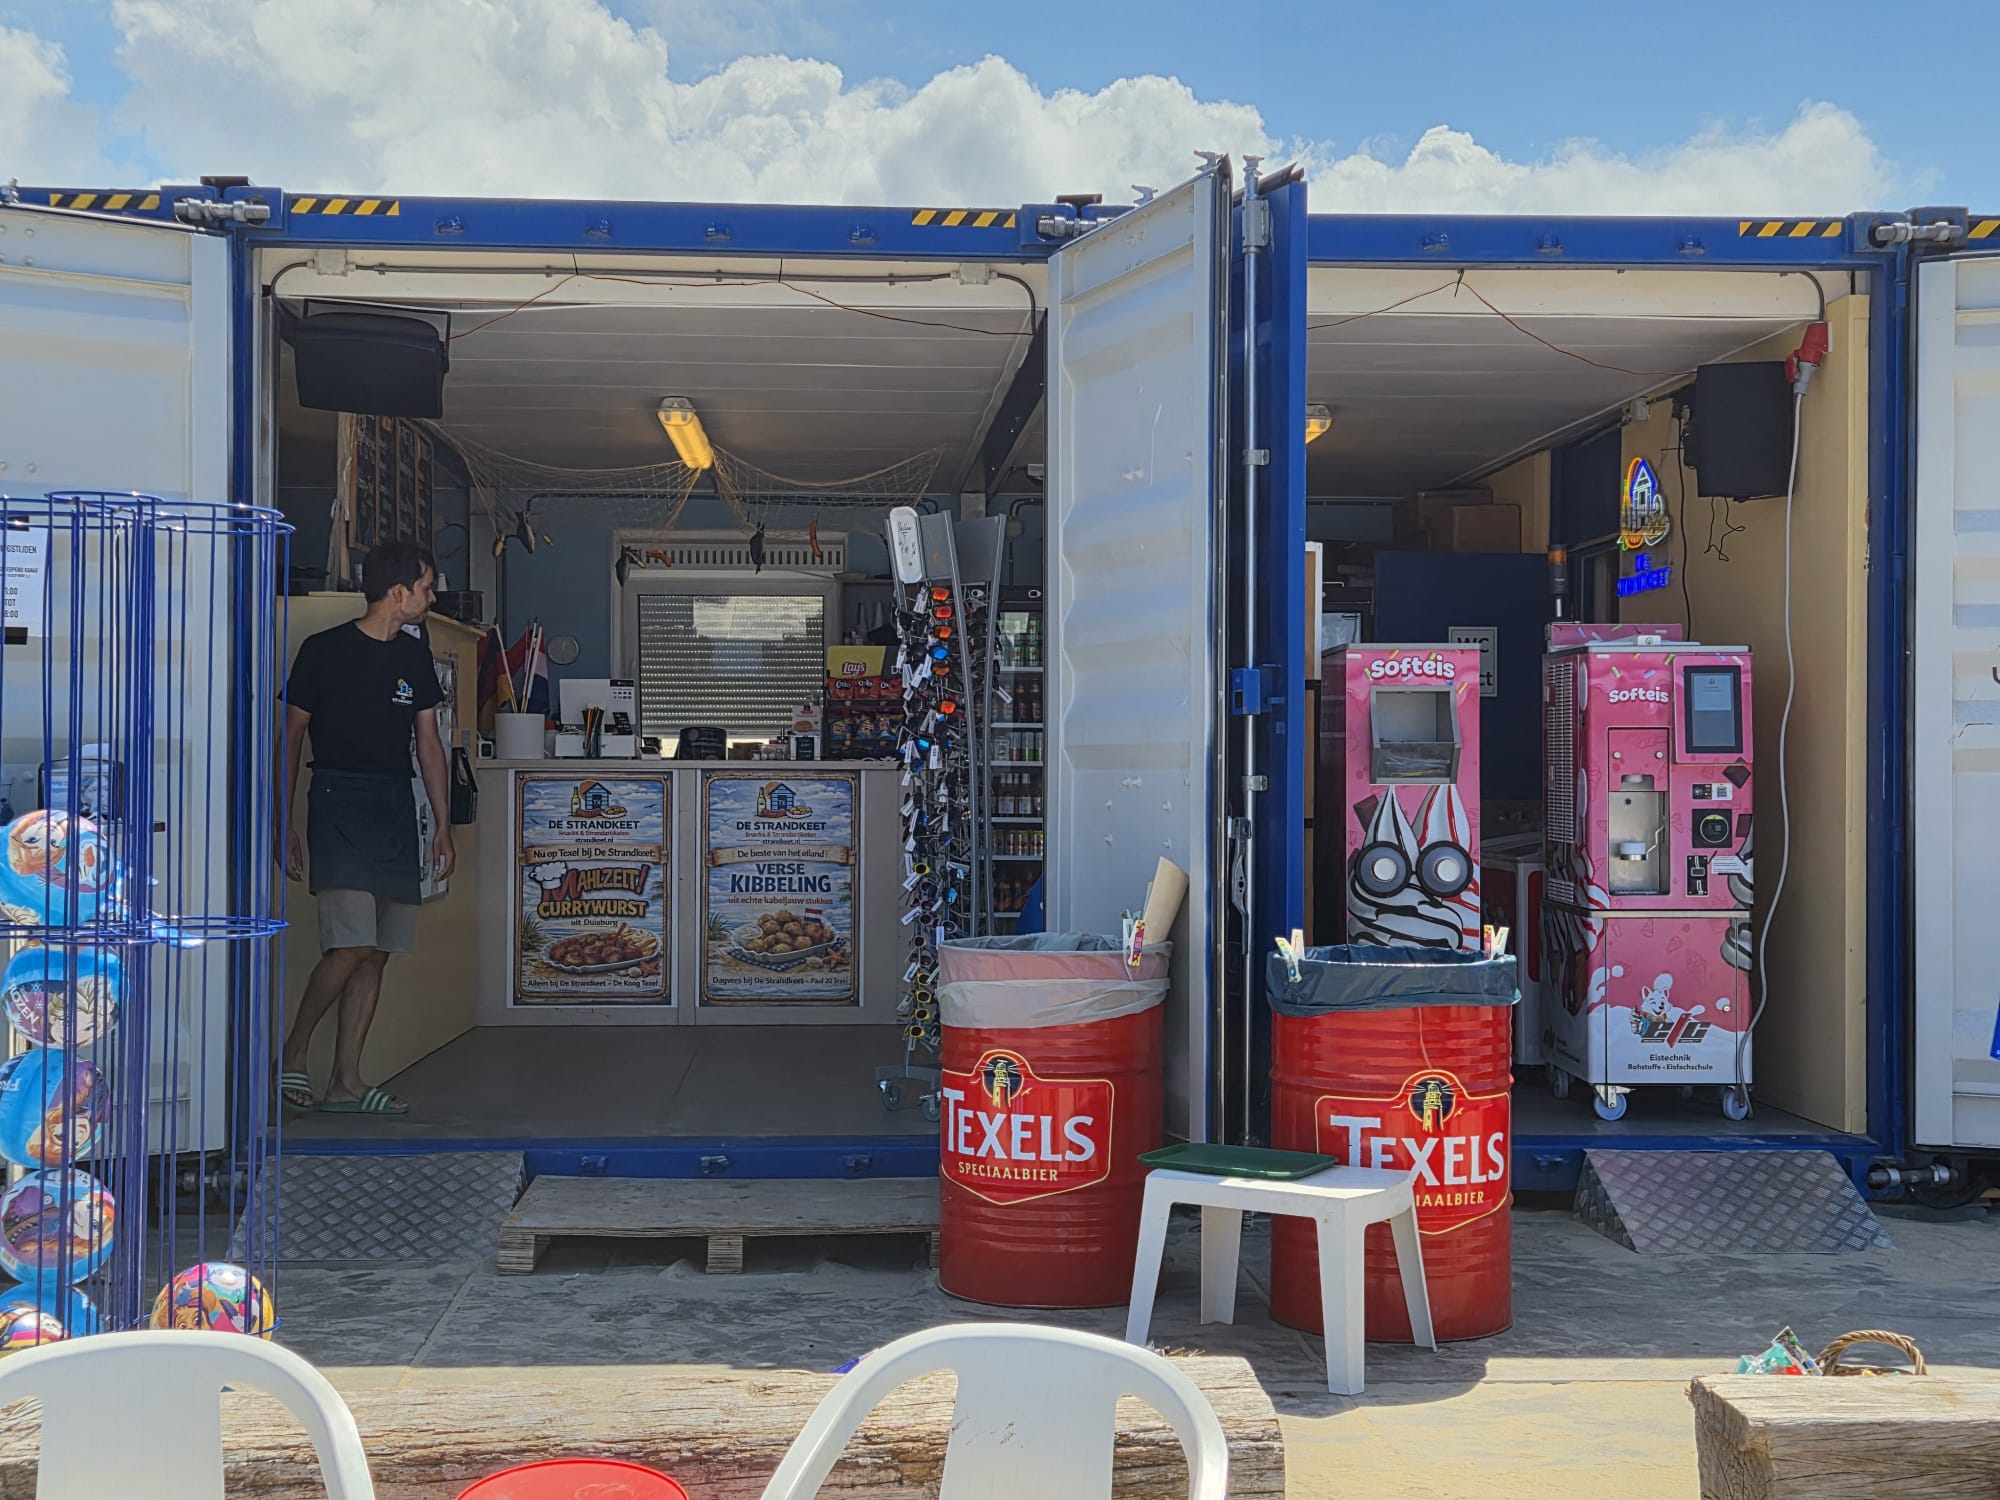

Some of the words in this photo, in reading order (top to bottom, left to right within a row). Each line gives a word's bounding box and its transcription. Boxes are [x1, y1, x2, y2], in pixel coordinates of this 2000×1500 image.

[1, 544, 37, 554] GSTIJDEN
[548, 820, 564, 829] DE
[566, 820, 641, 830] STRANDKEET
[736, 821, 752, 831] DE
[753, 821, 827, 831] STRANDKEET
[533, 850, 546, 859] Nu
[546, 850, 559, 860] op
[559, 847, 580, 858] Texel
[581, 847, 592, 859] bij
[594, 847, 607, 858] De
[737, 850, 749, 858] De
[750, 849, 772, 858] beste
[772, 849, 787, 857] van
[787, 848, 801, 857] het
[755, 863, 806, 875] VERSE
[730, 874, 832, 893] KIBBELING
[728, 895, 740, 904] uit
[740, 895, 763, 905] echte
[764, 895, 805, 906] kabeljauw
[805, 896, 833, 905] stukken
[537, 899, 650, 919] CURRYWURST
[570, 918, 581, 926] uit
[583, 918, 618, 928] Duisburg
[549, 979, 559, 988] bij
[560, 979, 570, 987] De
[570, 979, 607, 988] Strandkeet
[613, 979, 623, 987] De
[624, 979, 641, 988] Koog
[712, 976, 742, 985] Dagvers
[742, 976, 753, 986] bij
[754, 976, 764, 985] De
[765, 976, 804, 985] Strandkeet
[1649, 1053, 1692, 1062] Eistechnik
[1627, 1063, 1661, 1071] Rohstoffe
[1666, 1063, 1713, 1071] Eisfachschule
[943, 1087, 1096, 1162] TEXELS
[1331, 1115, 1505, 1187] TEXELS
[958, 1161, 1059, 1182] SPECIAALBIER
[1415, 1191, 1485, 1207] IAALBIER
